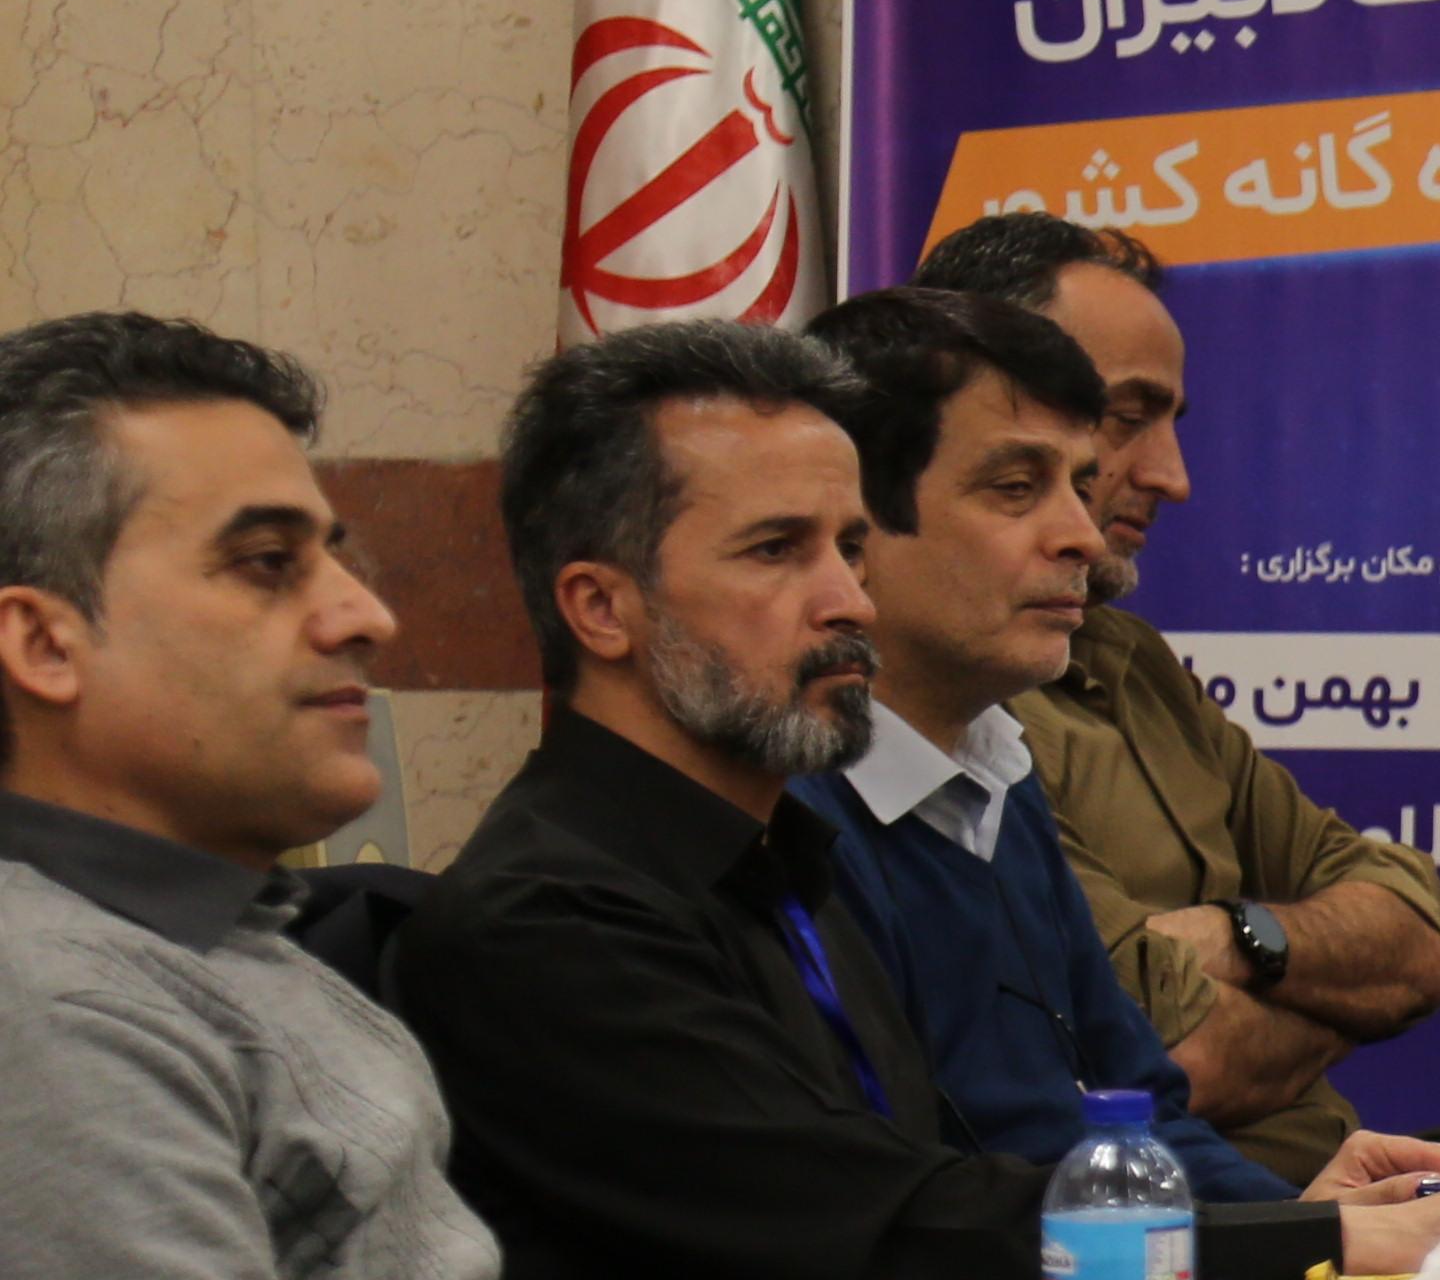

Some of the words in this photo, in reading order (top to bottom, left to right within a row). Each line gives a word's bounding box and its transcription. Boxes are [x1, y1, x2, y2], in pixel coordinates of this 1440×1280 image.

[983, 138, 1201, 230] کش
[1223, 110, 1393, 216] گانه
[1256, 542, 1356, 584] برگزاری
[1360, 545, 1435, 583] مکان
[1252, 675, 1420, 729] بهمن
